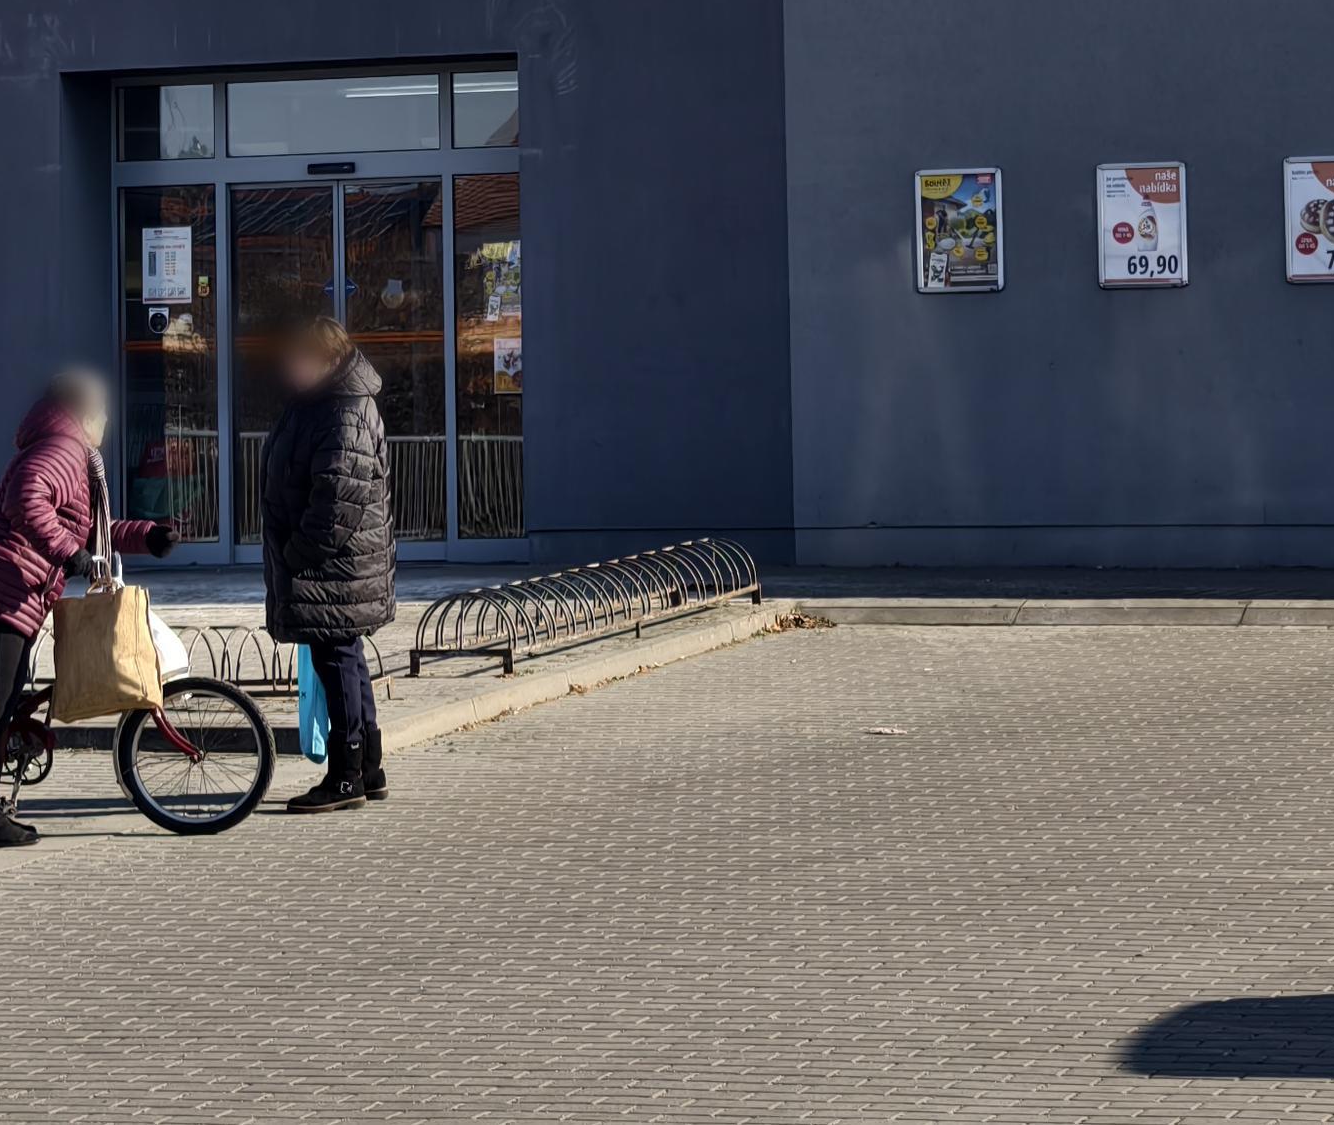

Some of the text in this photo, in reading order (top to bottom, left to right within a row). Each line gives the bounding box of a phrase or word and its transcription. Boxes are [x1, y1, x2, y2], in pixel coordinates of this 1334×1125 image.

[1155, 169, 1177, 181] naše
[1139, 181, 1177, 193] nabídka
[1127, 254, 1179, 277] 69,90
